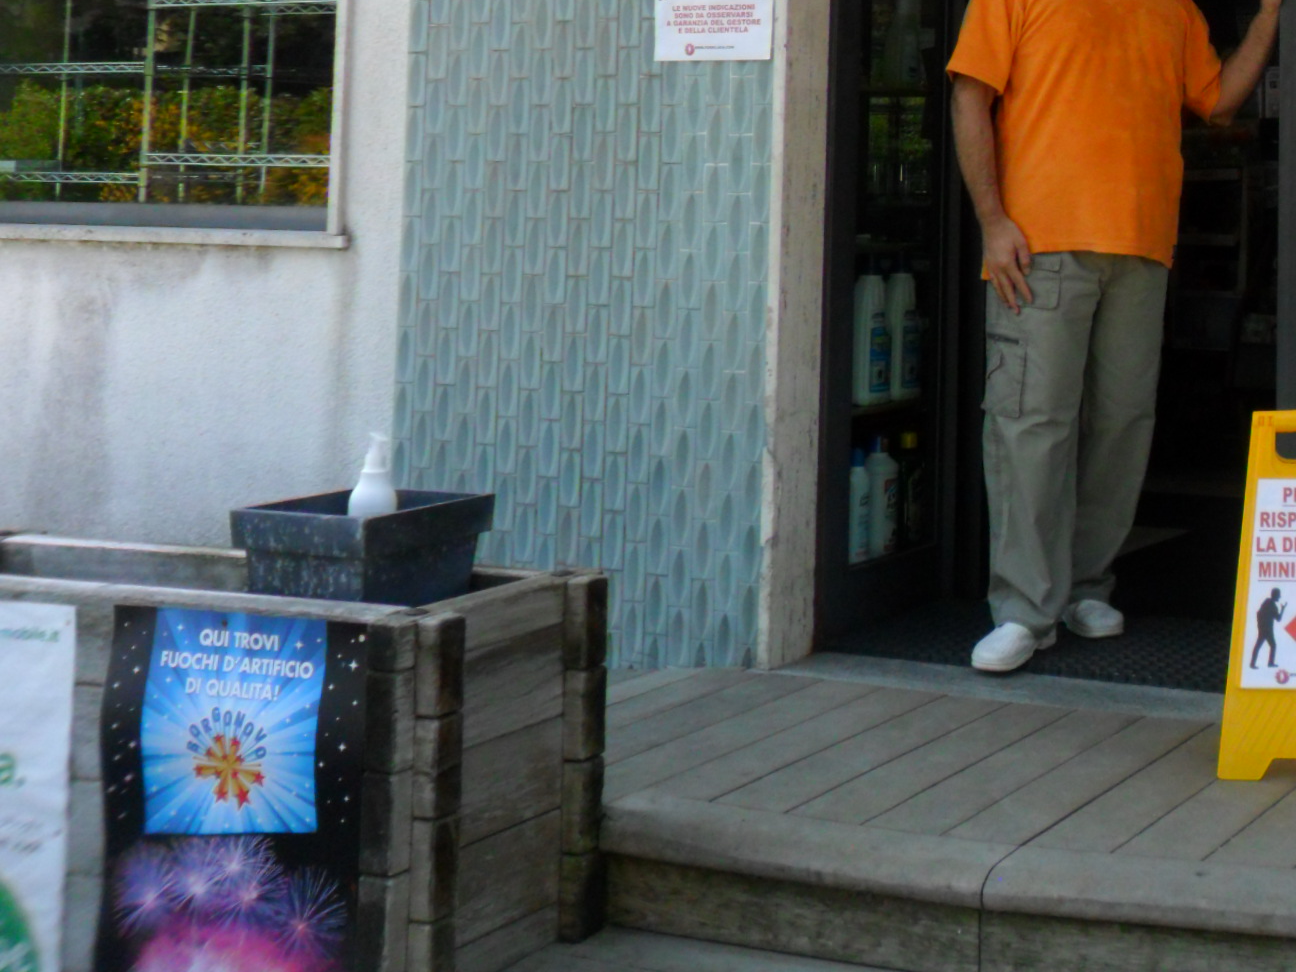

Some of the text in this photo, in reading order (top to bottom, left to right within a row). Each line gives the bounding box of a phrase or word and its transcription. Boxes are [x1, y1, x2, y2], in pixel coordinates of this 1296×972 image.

[1256, 537, 1276, 553] LA
[199, 629, 279, 651] QUI TROVI
[160, 651, 313, 679] FUOCHI D'ARTIFICIO
[185, 679, 199, 695] DI
[187, 707, 267, 759] BORGONOVO
